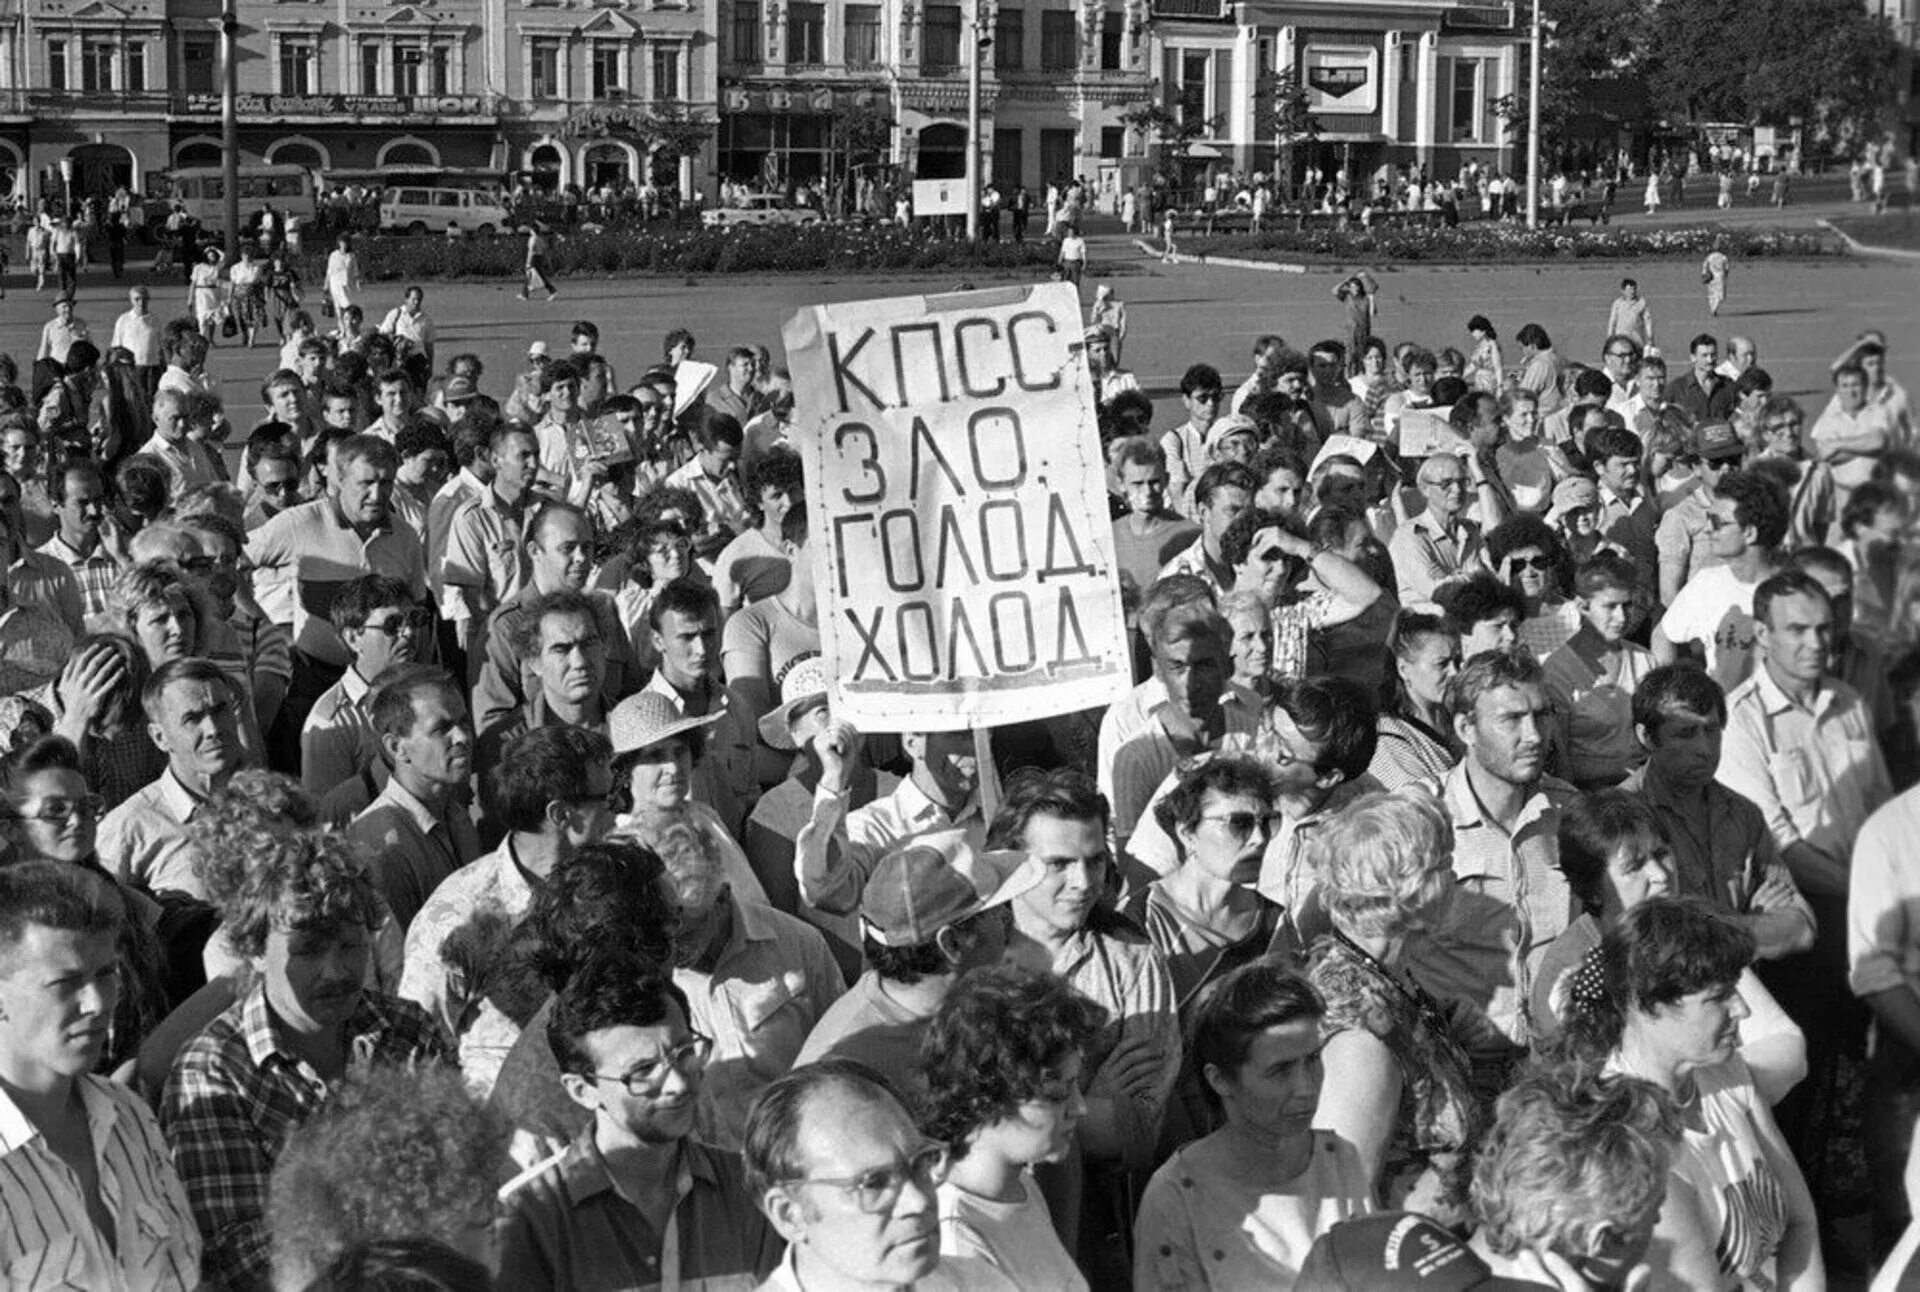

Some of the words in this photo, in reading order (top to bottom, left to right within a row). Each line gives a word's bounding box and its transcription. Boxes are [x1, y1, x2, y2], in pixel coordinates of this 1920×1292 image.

[413, 97, 478, 113] ШОК
[828, 311, 1061, 413] КПСС
[845, 585, 1102, 681] ХОЛОД
